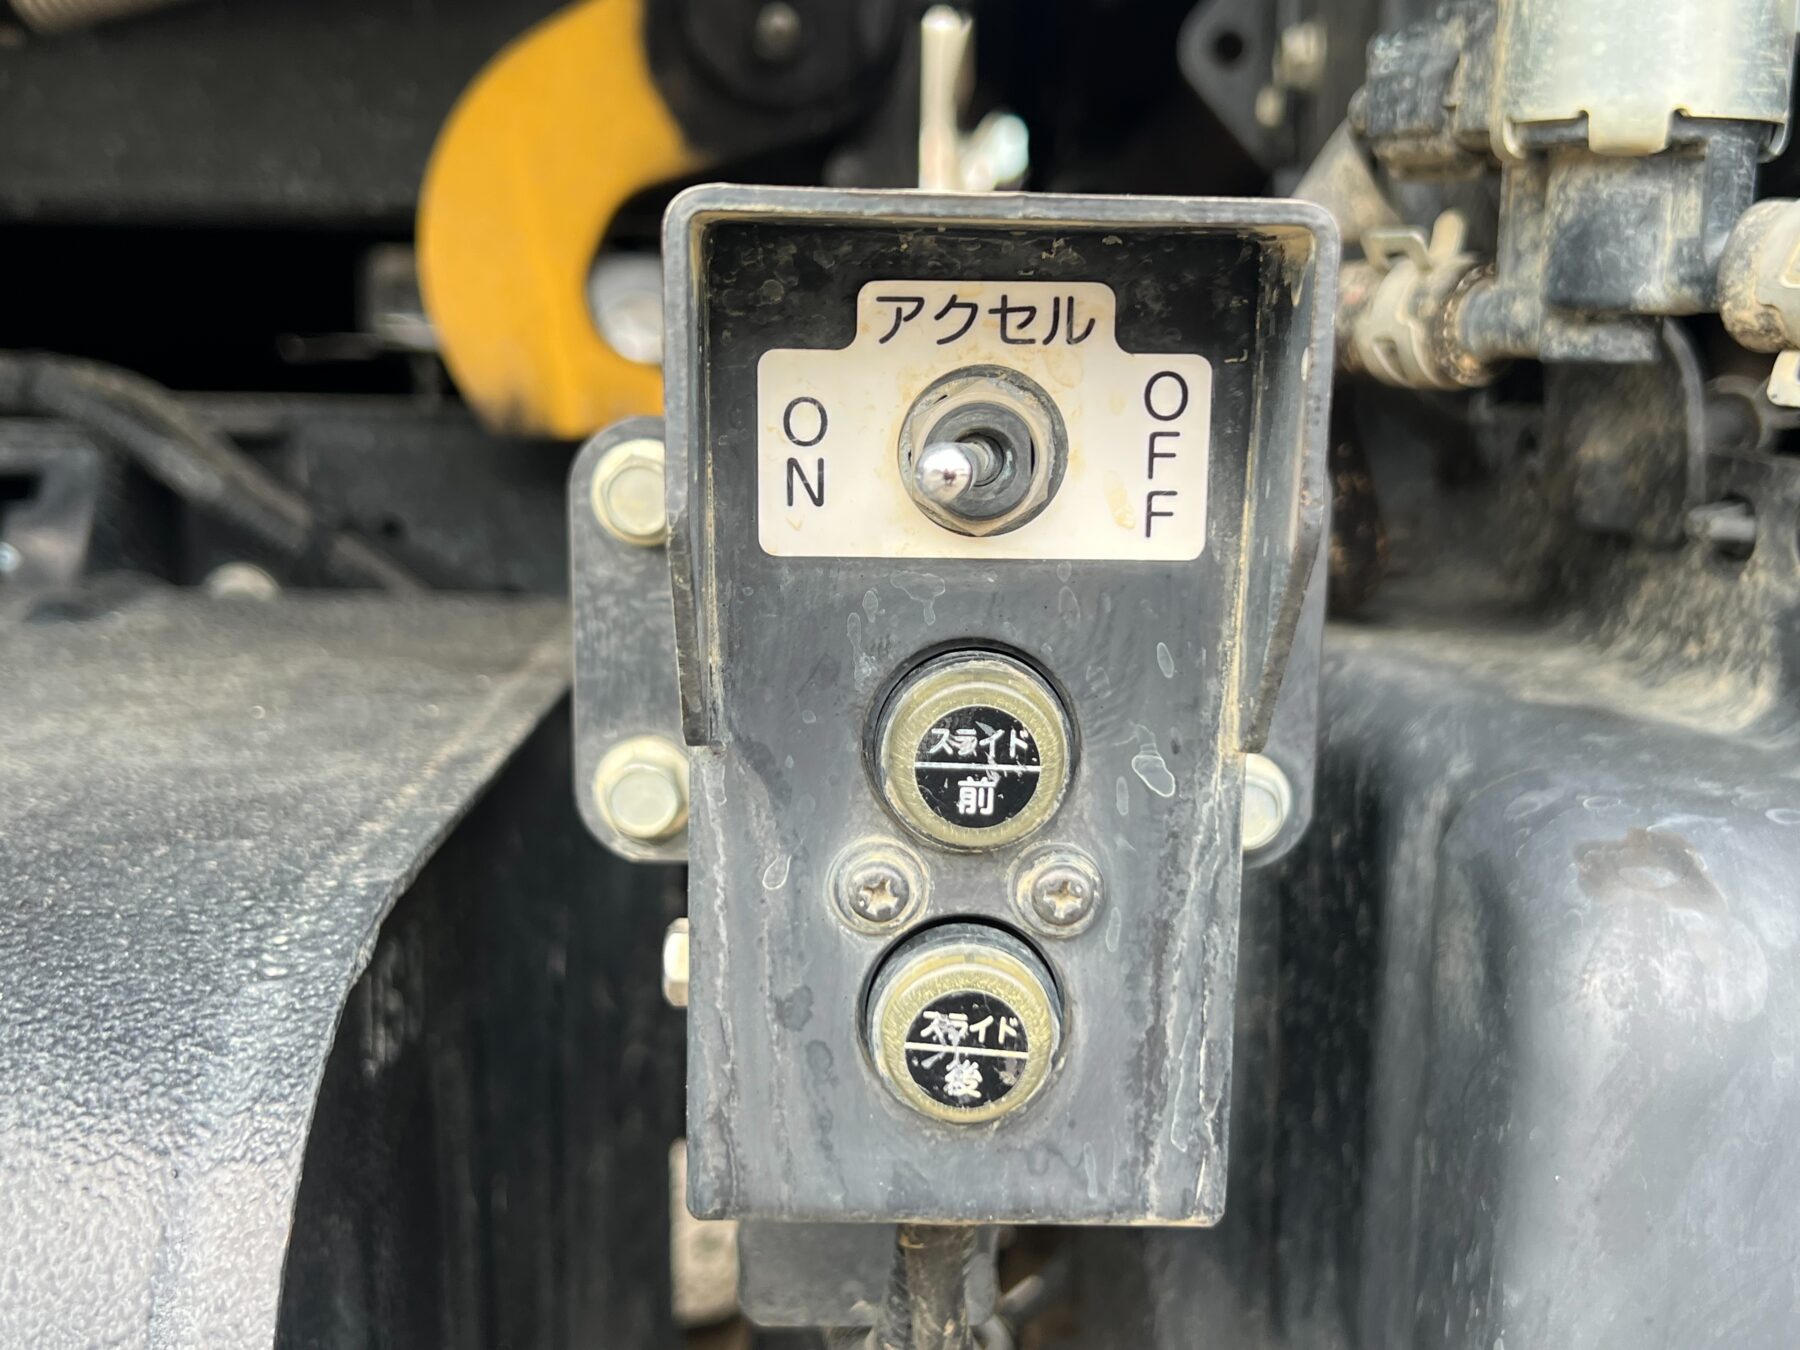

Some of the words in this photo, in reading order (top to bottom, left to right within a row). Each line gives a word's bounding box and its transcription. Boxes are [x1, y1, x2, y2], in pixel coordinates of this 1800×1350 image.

[876, 294, 1096, 345] アクセル
[783, 396, 828, 507] ON
[1143, 370, 1189, 538] OFF
[928, 727, 1028, 759] スライド
[957, 776, 998, 815] 前
[920, 1010, 1018, 1045] スライド
